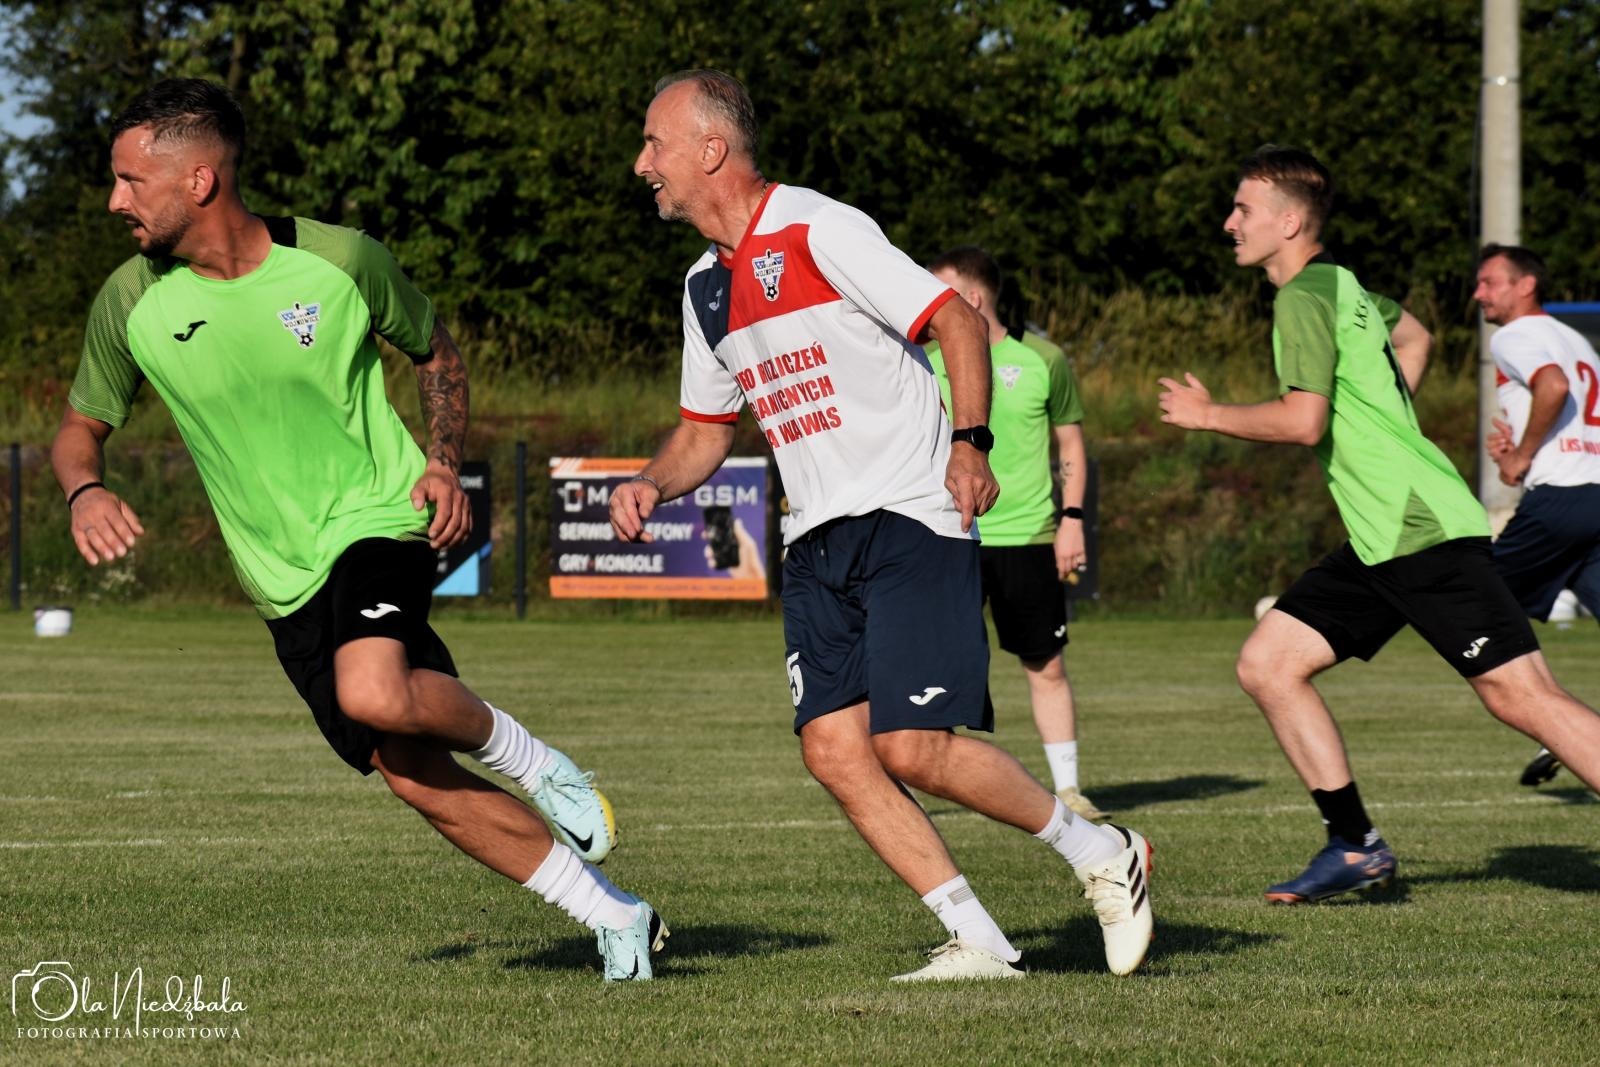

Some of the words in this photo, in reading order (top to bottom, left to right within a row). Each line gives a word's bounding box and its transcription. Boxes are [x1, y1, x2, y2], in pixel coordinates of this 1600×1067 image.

[695, 485, 758, 506] GSM
[559, 522, 614, 541] SERWIS
[595, 554, 664, 573] KONSOLE
